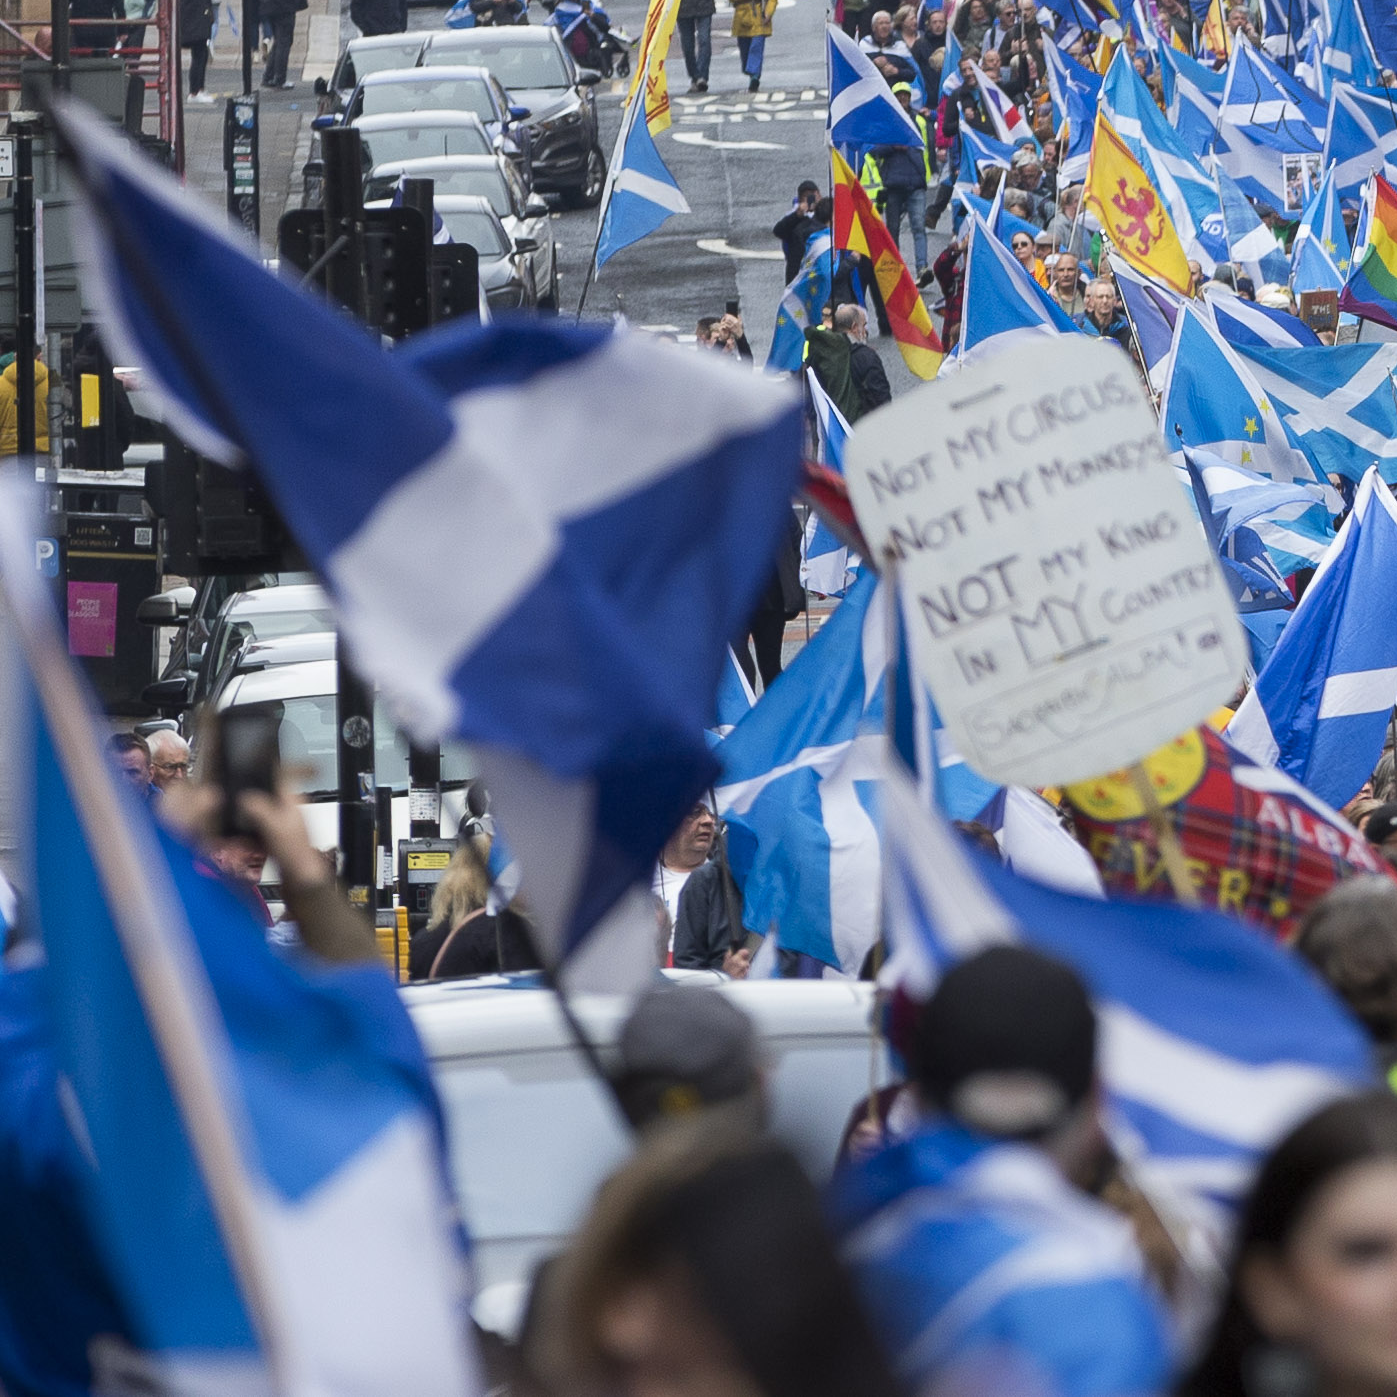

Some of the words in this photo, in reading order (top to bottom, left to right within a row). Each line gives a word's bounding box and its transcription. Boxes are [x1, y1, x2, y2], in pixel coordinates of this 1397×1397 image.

[945, 418, 999, 469] MY
[977, 469, 1032, 523] MY
[917, 555, 1021, 638] NOT
[1040, 540, 1088, 583] MY
[1011, 582, 1093, 669] MY
